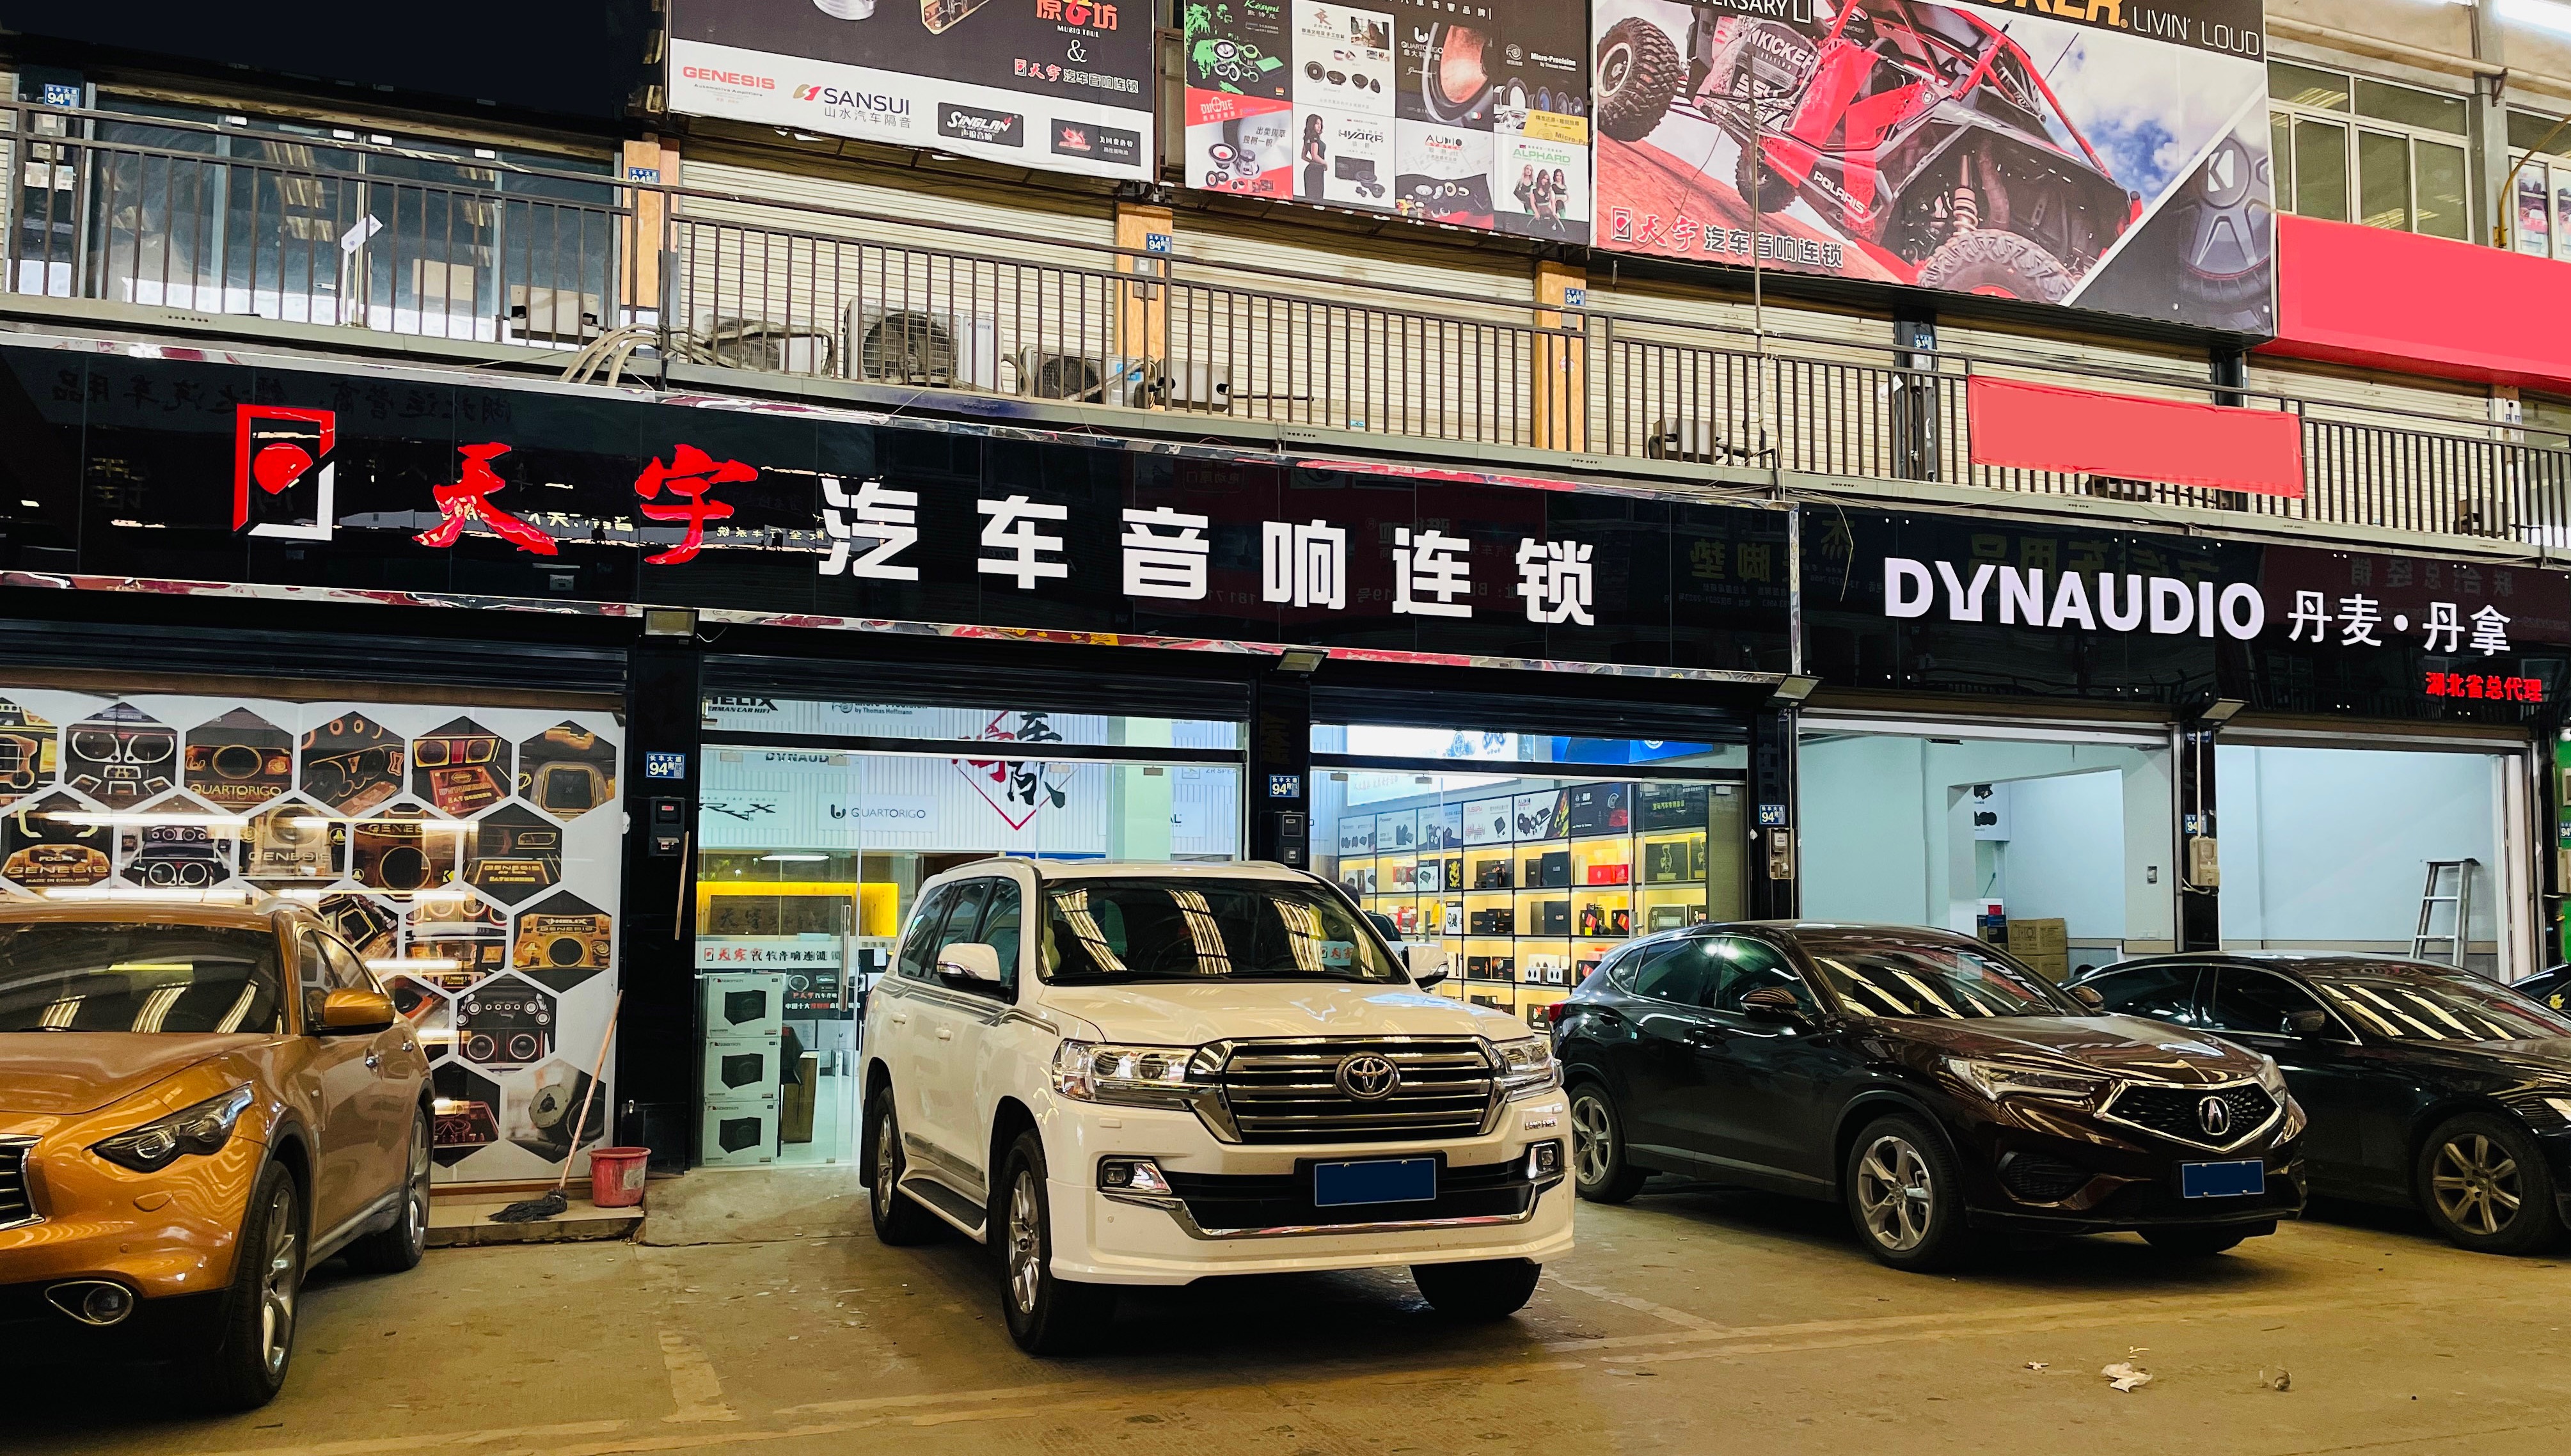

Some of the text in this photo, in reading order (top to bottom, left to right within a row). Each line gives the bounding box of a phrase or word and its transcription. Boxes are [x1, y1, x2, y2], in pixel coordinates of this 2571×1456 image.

[2201, 20, 2259, 56] LOUD
[1067, 39, 1087, 63] &
[683, 66, 775, 90] GENESIS
[1063, 68, 1139, 93] 汽车音响连锁
[824, 88, 910, 115] SANSUI
[825, 106, 912, 129] 山水汽车隔音
[1513, 148, 1571, 164] ALPHARD
[1814, 170, 1867, 214] POLARIS
[1636, 215, 1844, 268] 天宇 汽车音响连锁
[412, 441, 1594, 626] 天宇 汽车音响连锁
[1885, 557, 2512, 657] DYNAUDIO 丹麦·丹拿
[2426, 671, 2543, 703] 湖北省总代理
[766, 752, 830, 763] DYNAUD
[189, 783, 282, 797] QUARTORIGO
[7, 866, 108, 874] GENESIS
